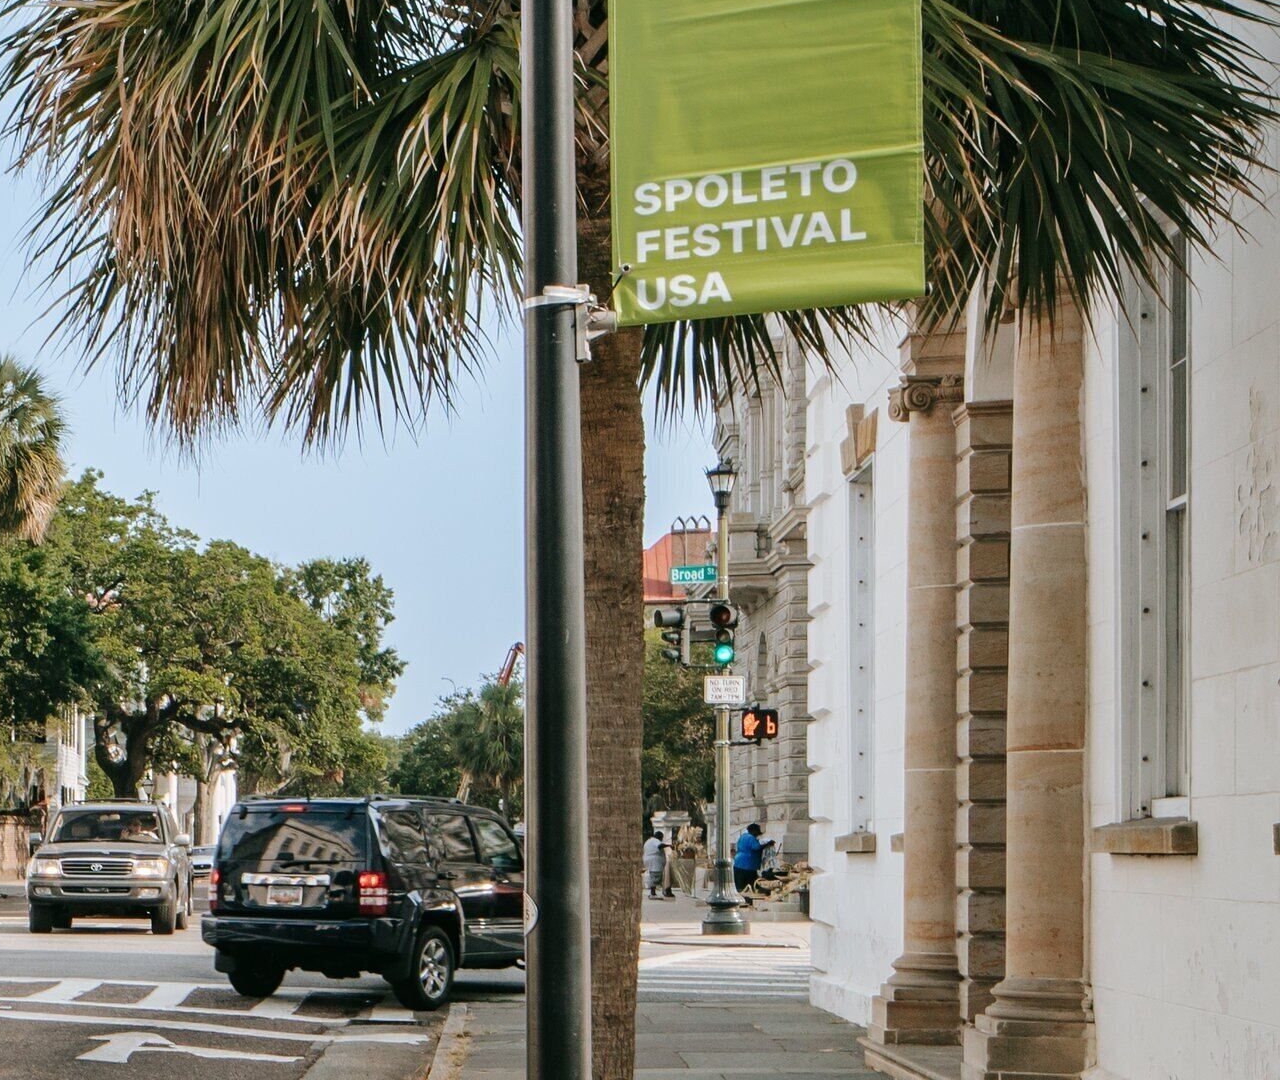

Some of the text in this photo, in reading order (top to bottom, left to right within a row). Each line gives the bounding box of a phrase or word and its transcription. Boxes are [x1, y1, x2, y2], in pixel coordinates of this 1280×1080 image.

[634, 159, 858, 216] SPOLETO
[636, 208, 867, 264] FESTIVAL
[636, 271, 733, 311] USA
[671, 568, 705, 581] Broad
